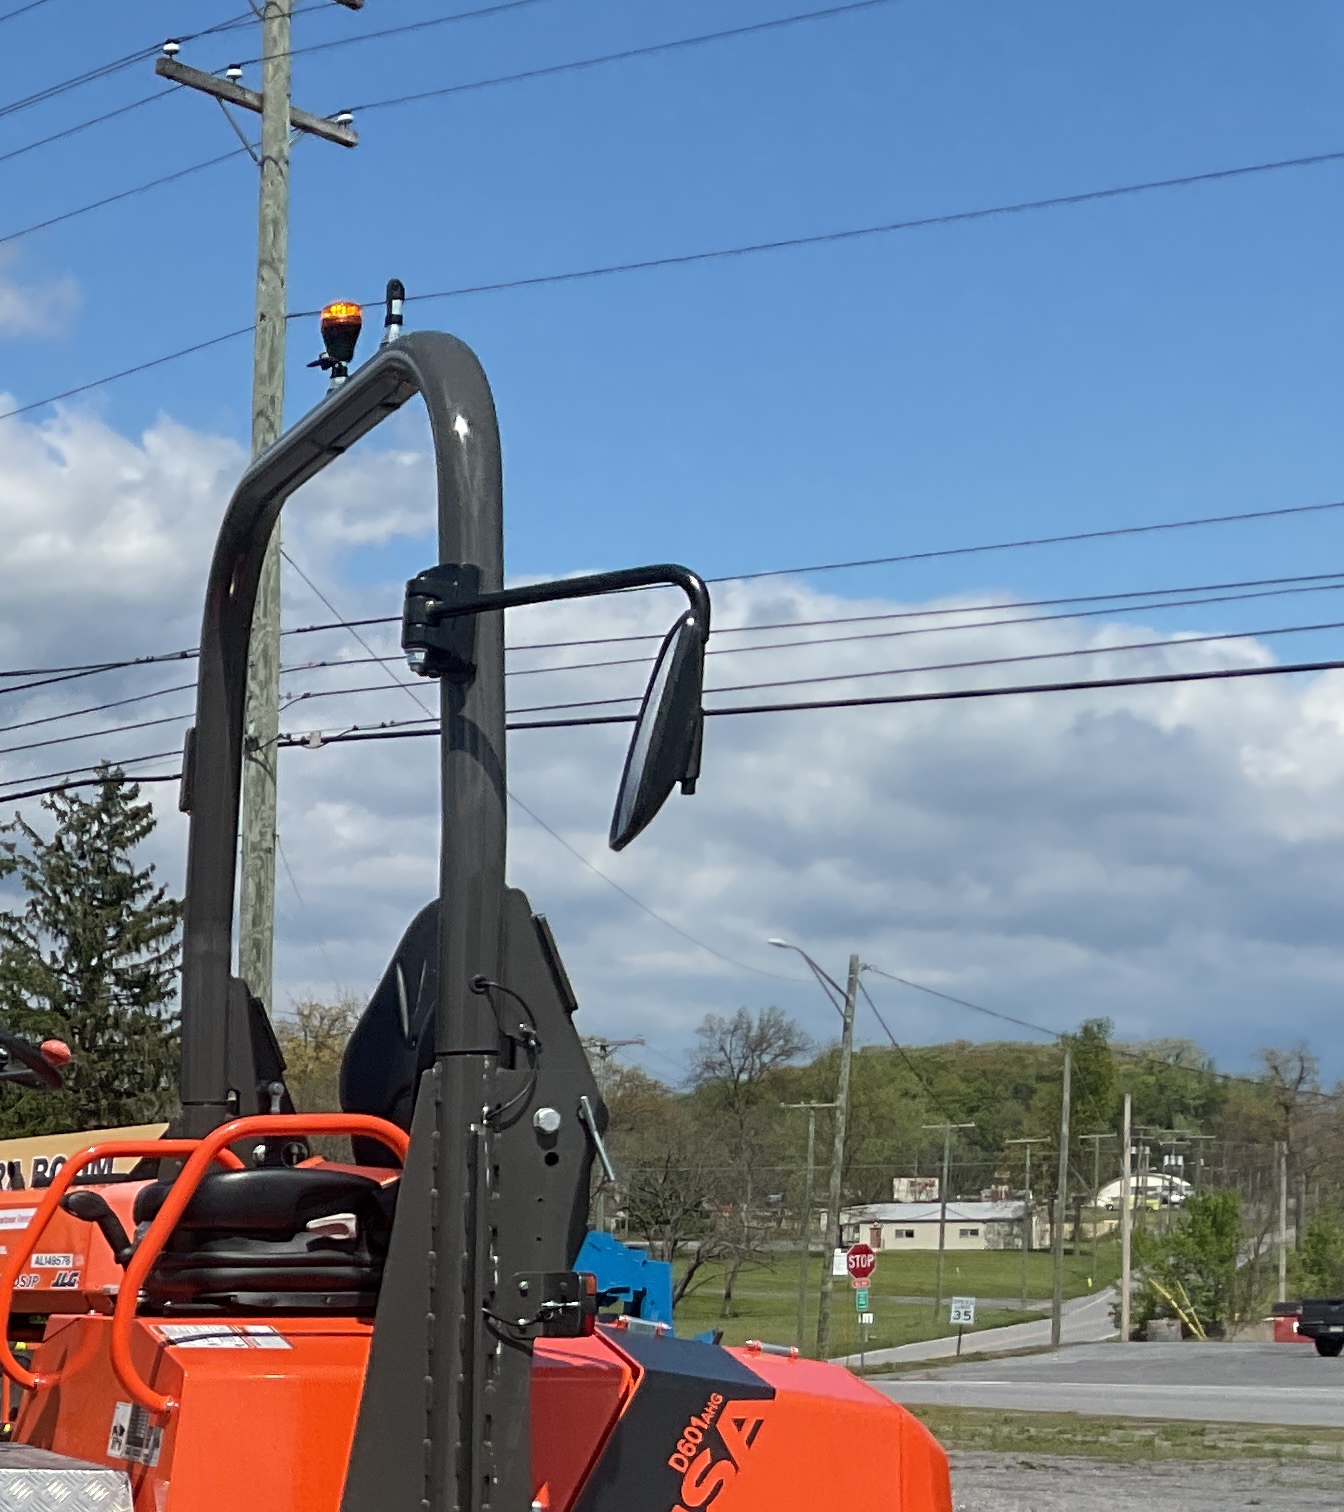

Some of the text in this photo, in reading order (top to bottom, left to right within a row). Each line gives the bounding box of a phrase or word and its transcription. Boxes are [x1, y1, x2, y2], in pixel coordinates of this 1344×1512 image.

[30, 1155, 114, 1188] BOM
[848, 1253, 875, 1270] STOP
[51, 1271, 80, 1288] JLG
[952, 1309, 973, 1321] 35
